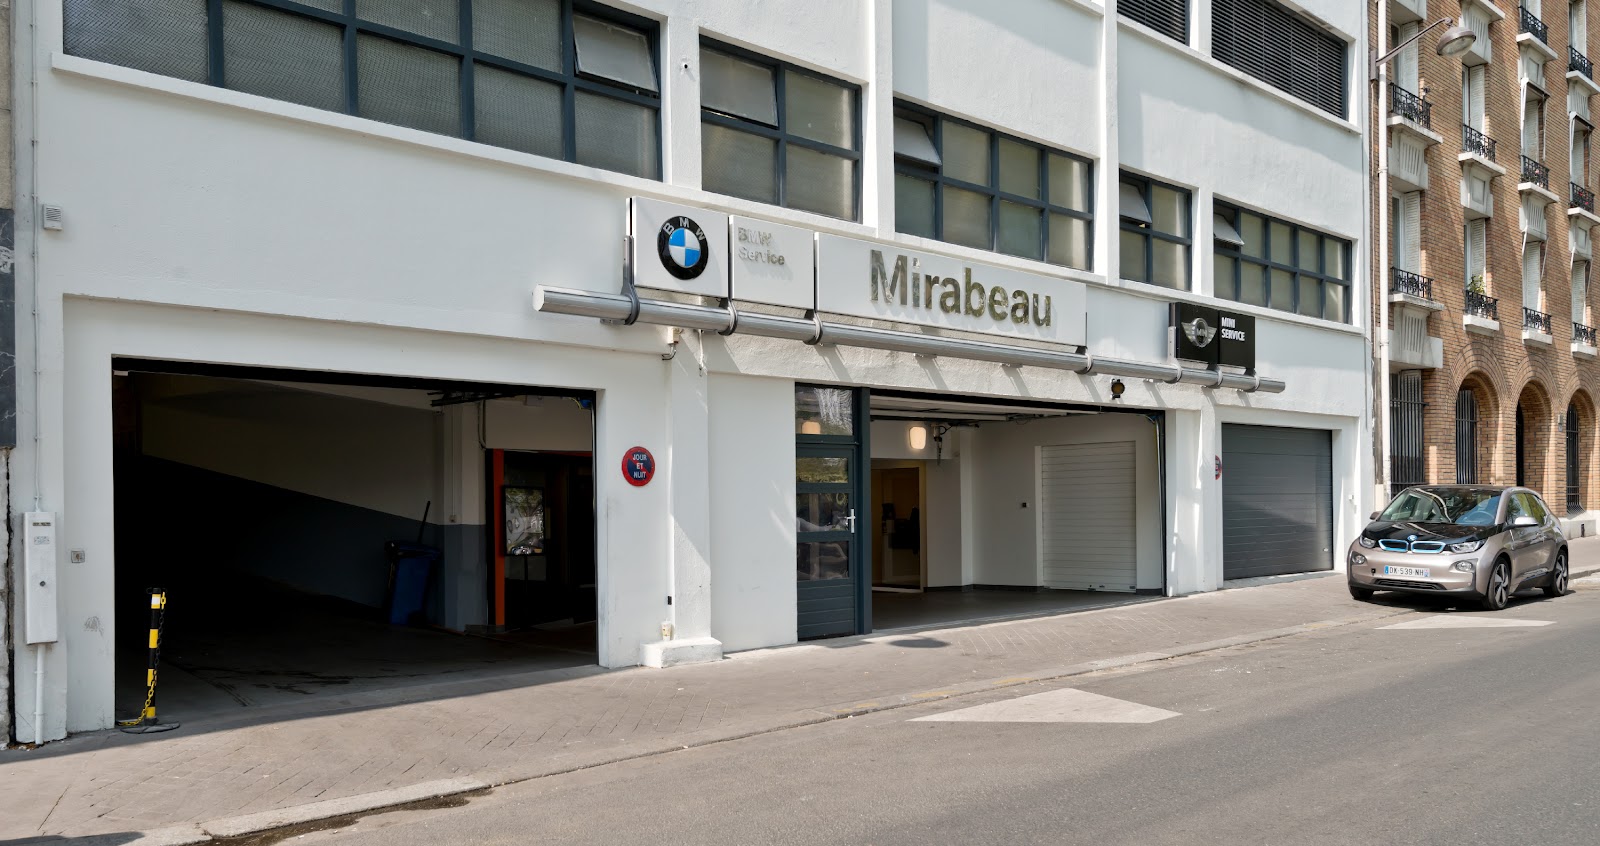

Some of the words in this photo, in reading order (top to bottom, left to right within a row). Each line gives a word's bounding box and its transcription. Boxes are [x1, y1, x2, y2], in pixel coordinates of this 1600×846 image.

[663, 216, 706, 241] BMW
[737, 226, 772, 246] BMW
[738, 246, 786, 266] Service
[870, 249, 1051, 327] Mirabeau
[1221, 317, 1236, 328] MINI
[1221, 328, 1245, 341] SERVICE
